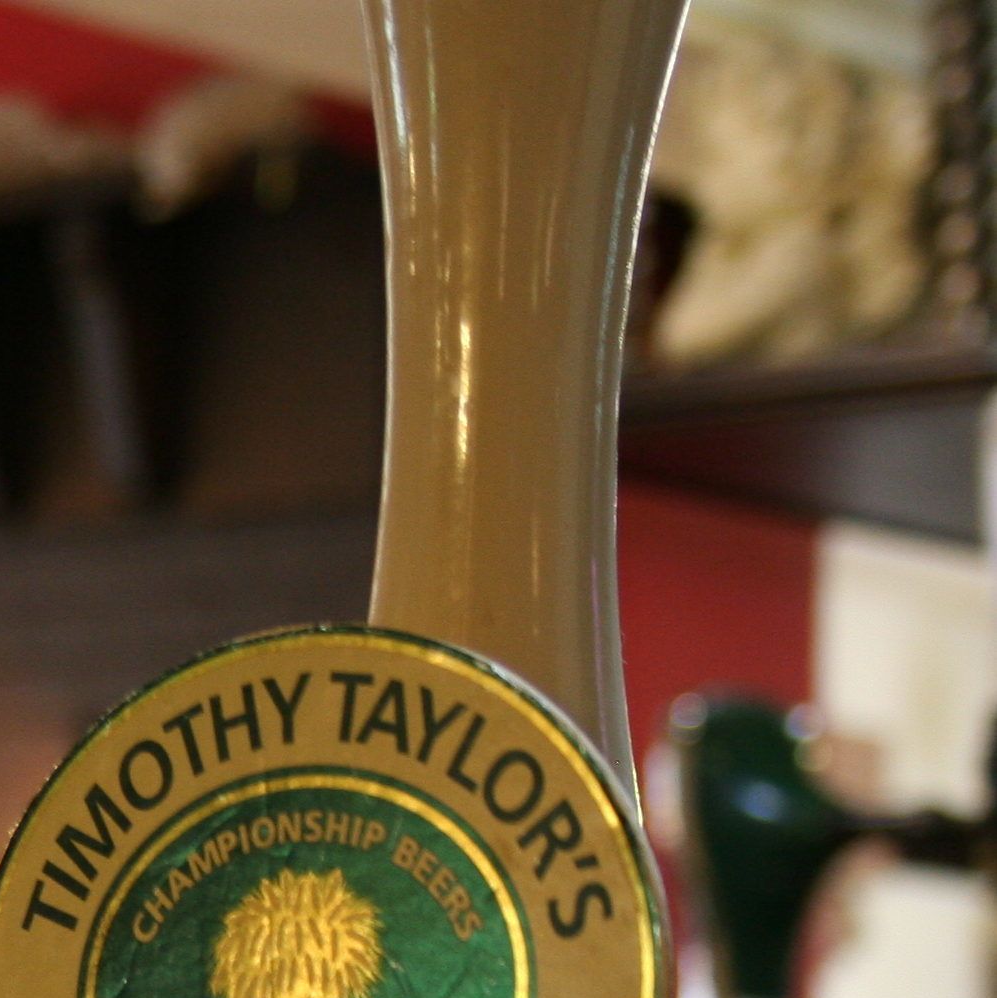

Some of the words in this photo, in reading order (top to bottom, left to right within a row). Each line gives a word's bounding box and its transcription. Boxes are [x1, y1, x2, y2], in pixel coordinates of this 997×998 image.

[22, 673, 312, 934] TIMOTHY
[330, 672, 615, 940] TAYLOR'S
[132, 810, 388, 943] CHAMPIONSHIP
[391, 835, 483, 941] BEERS
